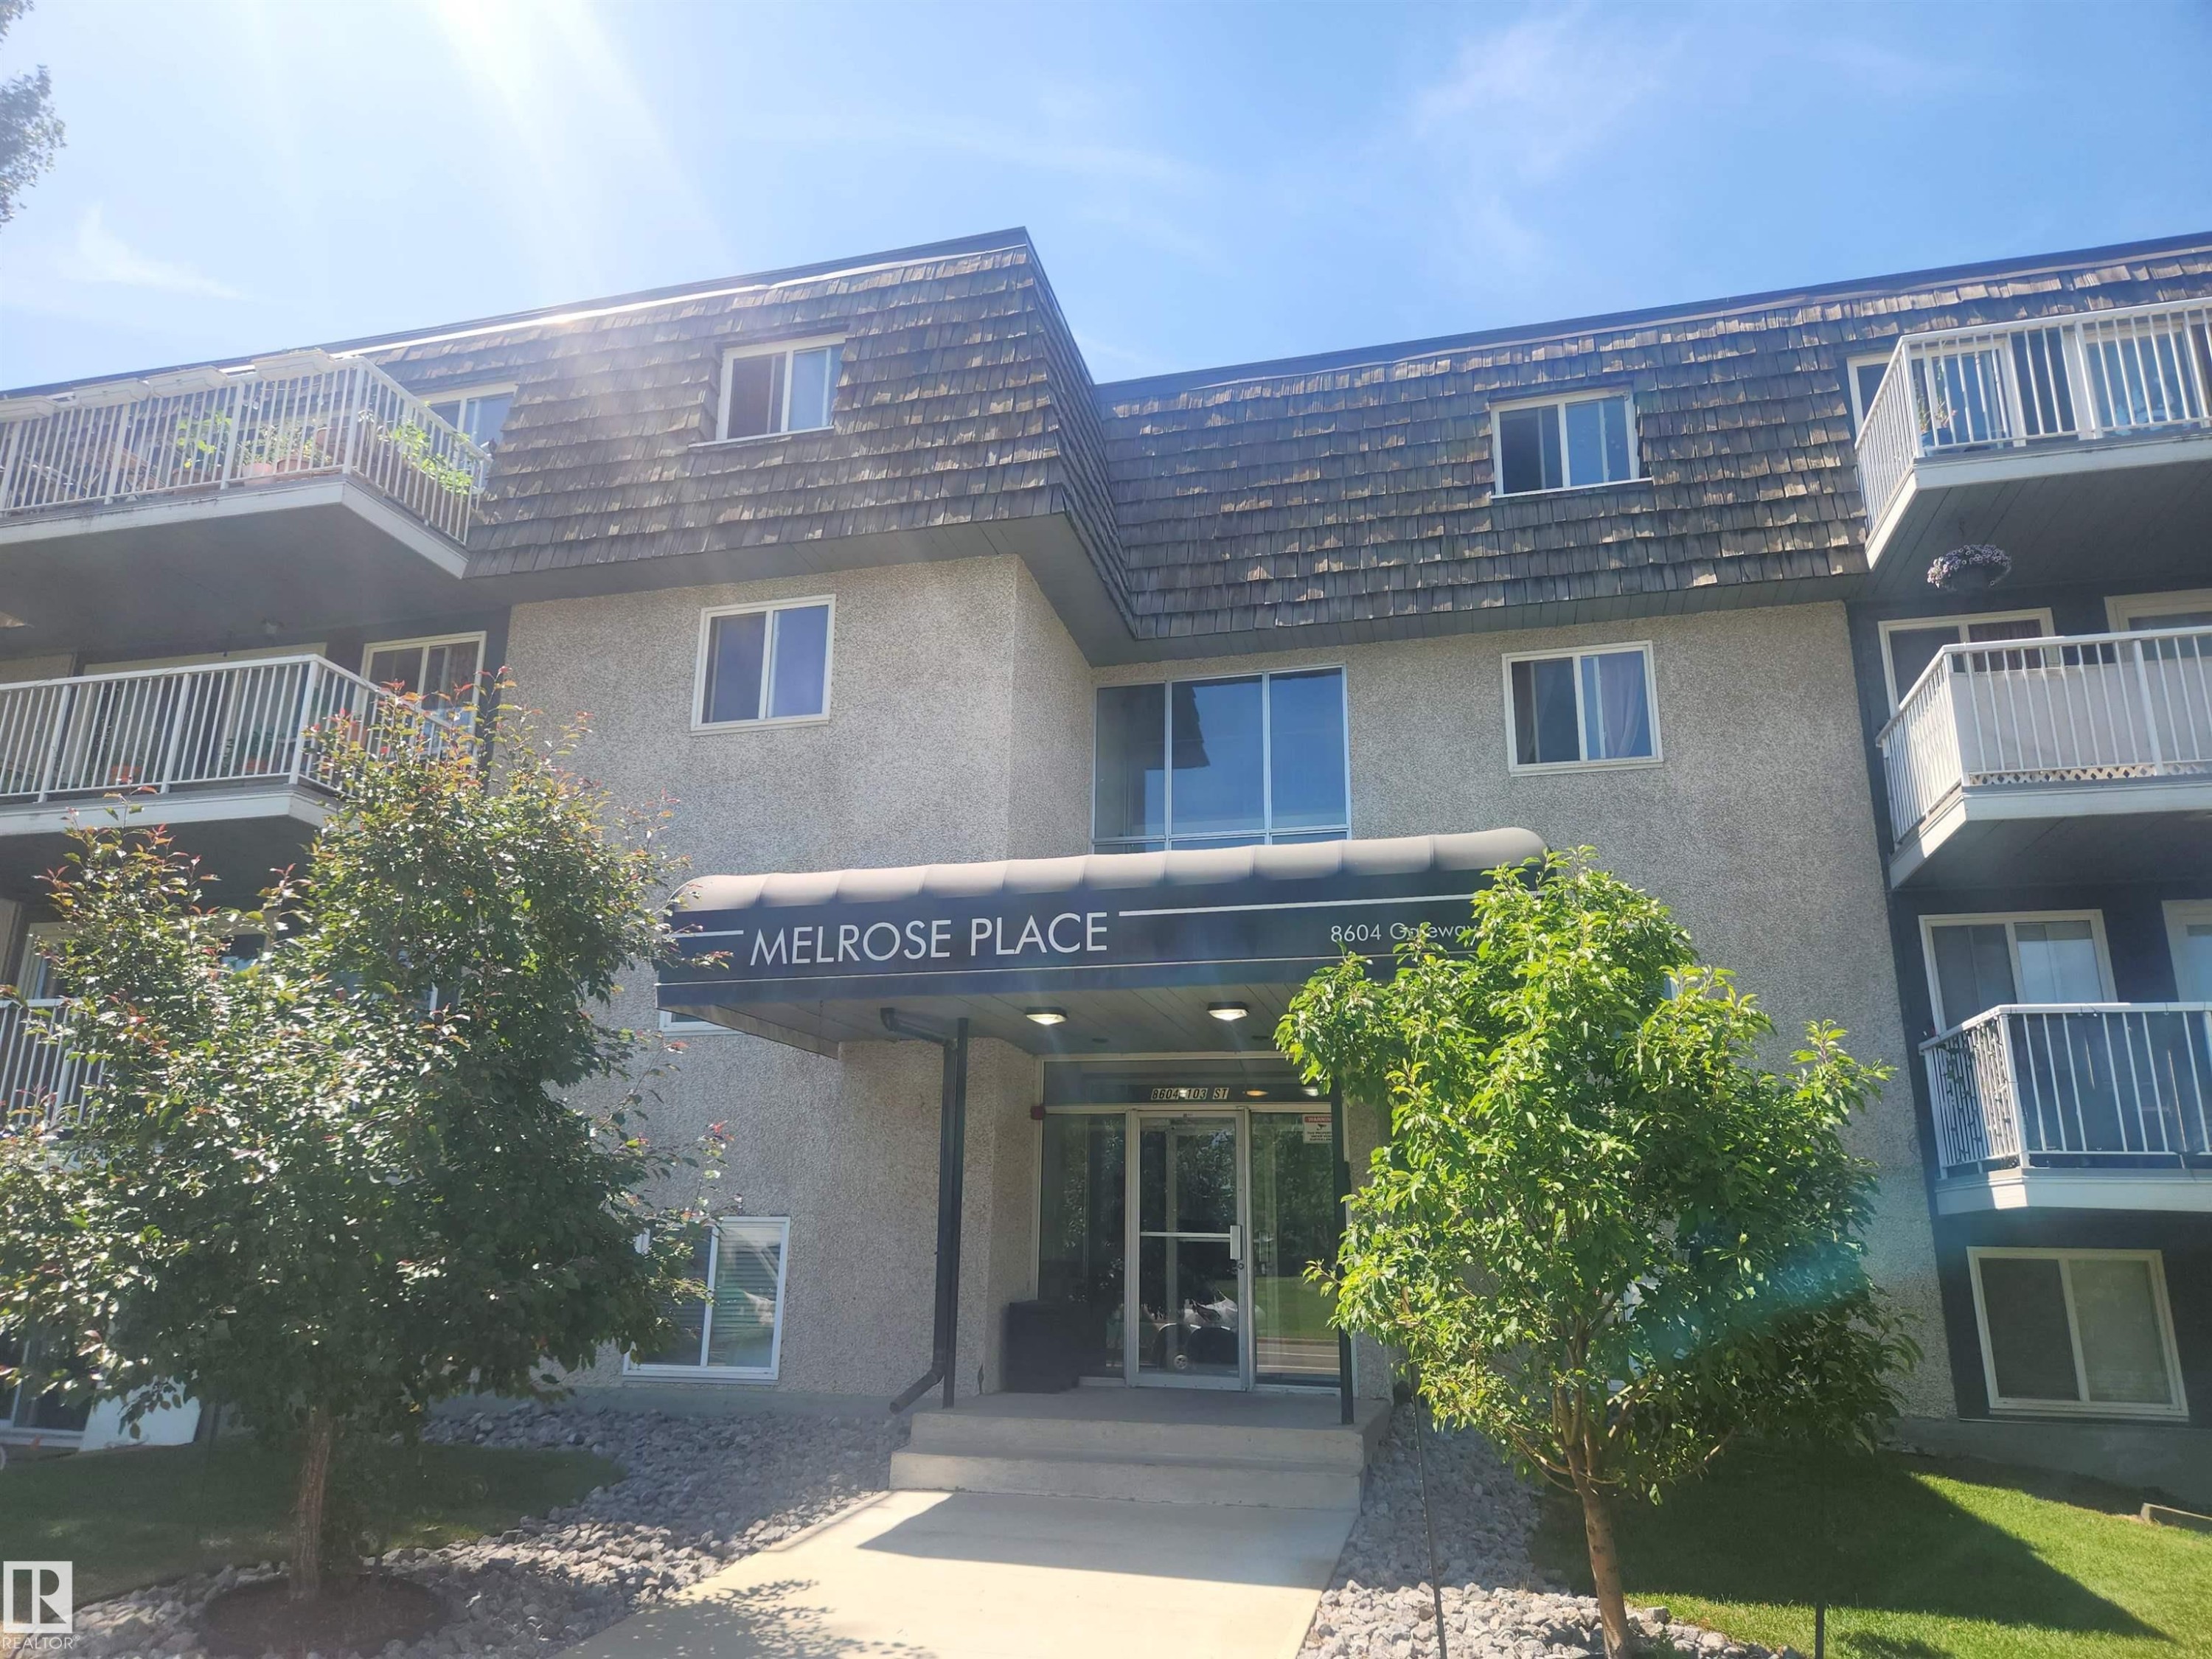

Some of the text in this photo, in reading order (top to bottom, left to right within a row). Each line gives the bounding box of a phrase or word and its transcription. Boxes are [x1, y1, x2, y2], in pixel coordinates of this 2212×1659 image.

[751, 912, 1107, 966] MELROSE PLACE
[1330, 923, 1382, 942] 8604
[1214, 1088, 1228, 1099] ST
